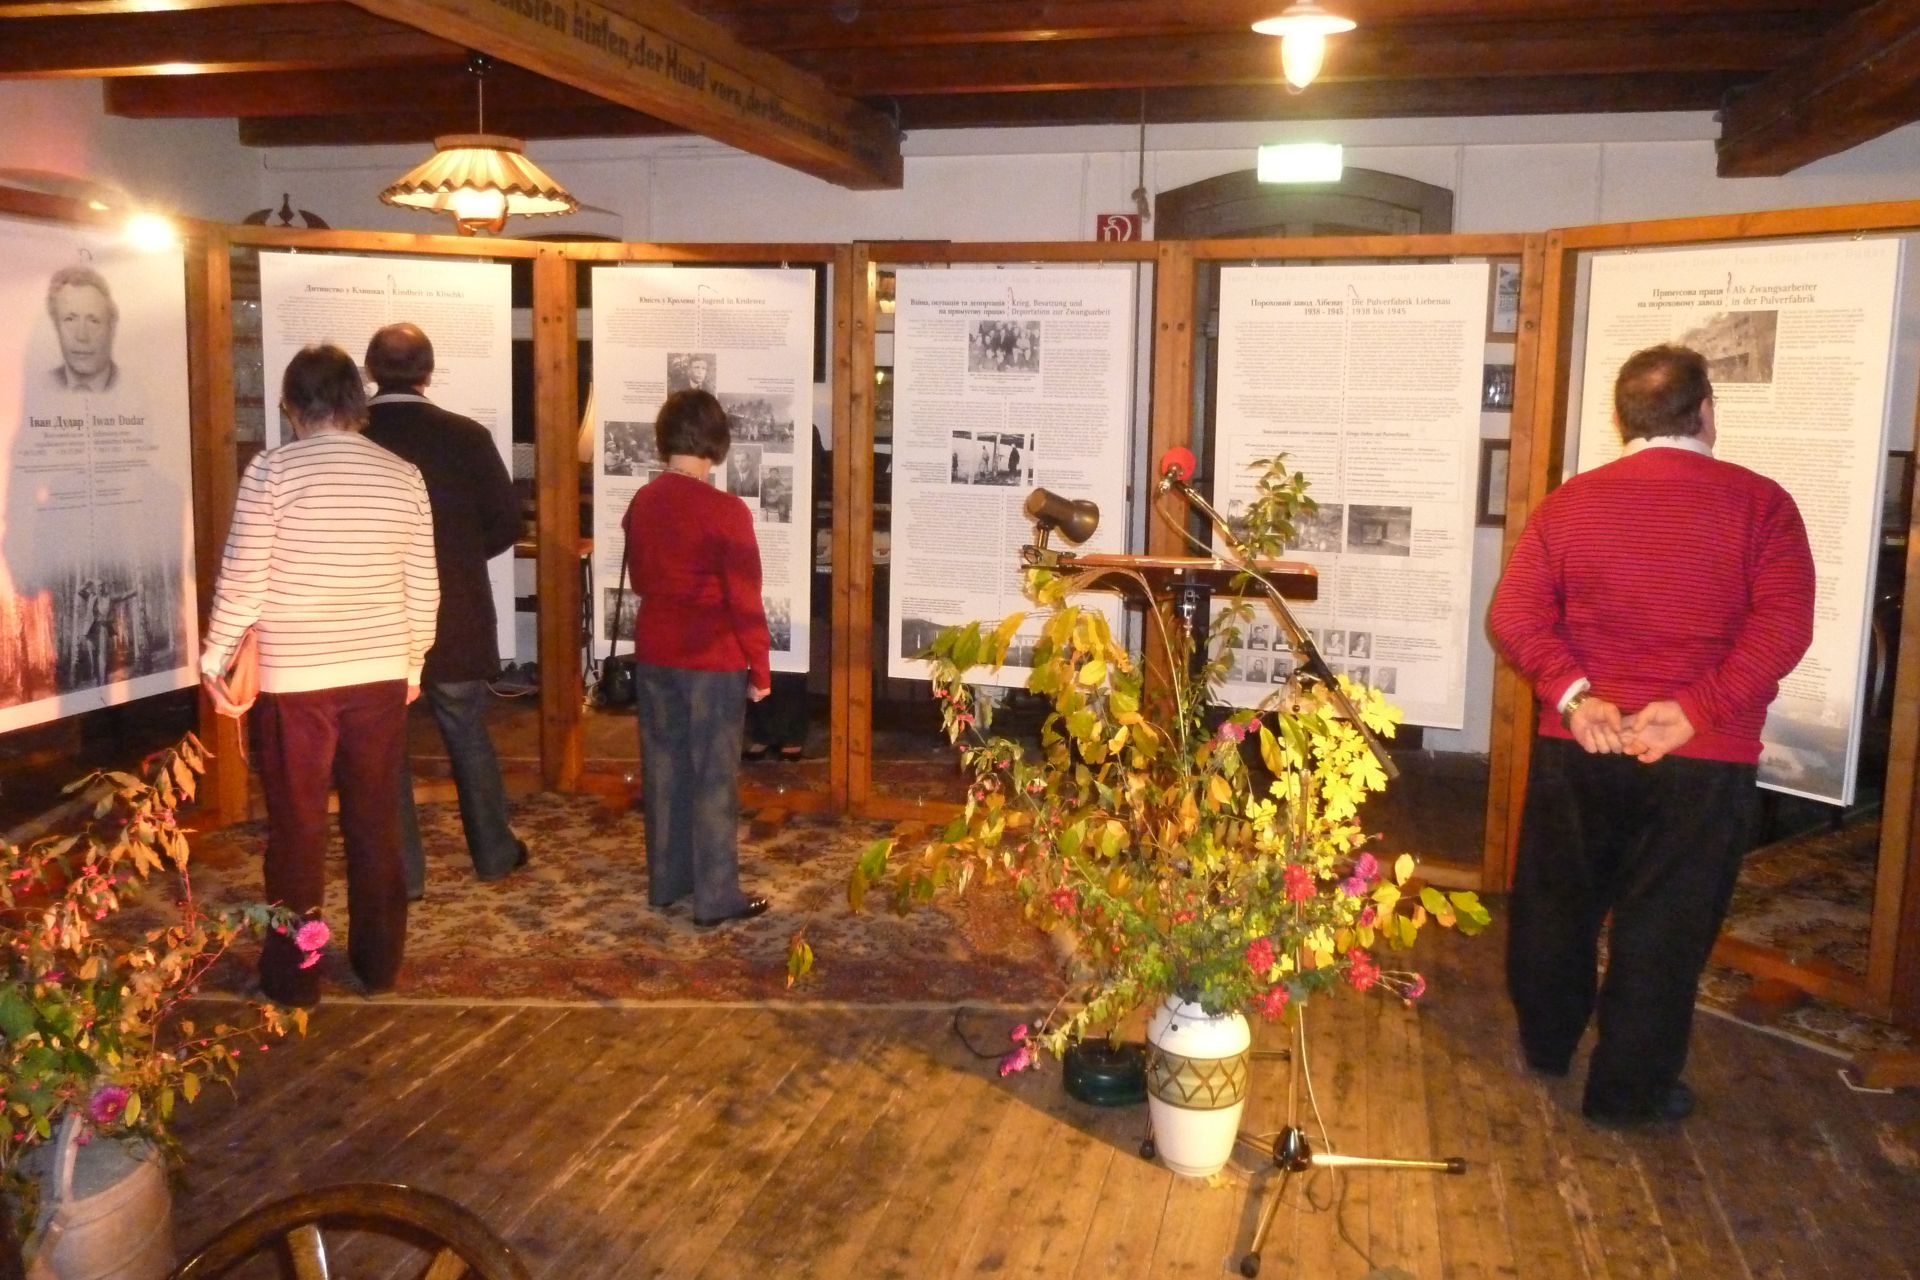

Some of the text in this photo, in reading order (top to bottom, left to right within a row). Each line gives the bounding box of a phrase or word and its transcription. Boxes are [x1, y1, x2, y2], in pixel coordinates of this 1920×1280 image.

[392, 287, 424, 297] Kindheit
[1733, 282, 1818, 294] Als Zwangsarbeiter
[702, 297, 725, 306] Jugend
[1033, 300, 1067, 308] Besatzung
[1069, 299, 1083, 307] und
[1351, 297, 1451, 306] Die Pulverfabrik Liebenau
[1743, 296, 1758, 305] der
[1760, 294, 1816, 305] Pulverfabrik
[1012, 308, 1051, 317] Deportation
[1066, 308, 1110, 317] Zwangsarbeit
[1373, 307, 1384, 315] bis
[1387, 307, 1407, 315] 1945
[92, 414, 145, 426] Iwan Dudar
